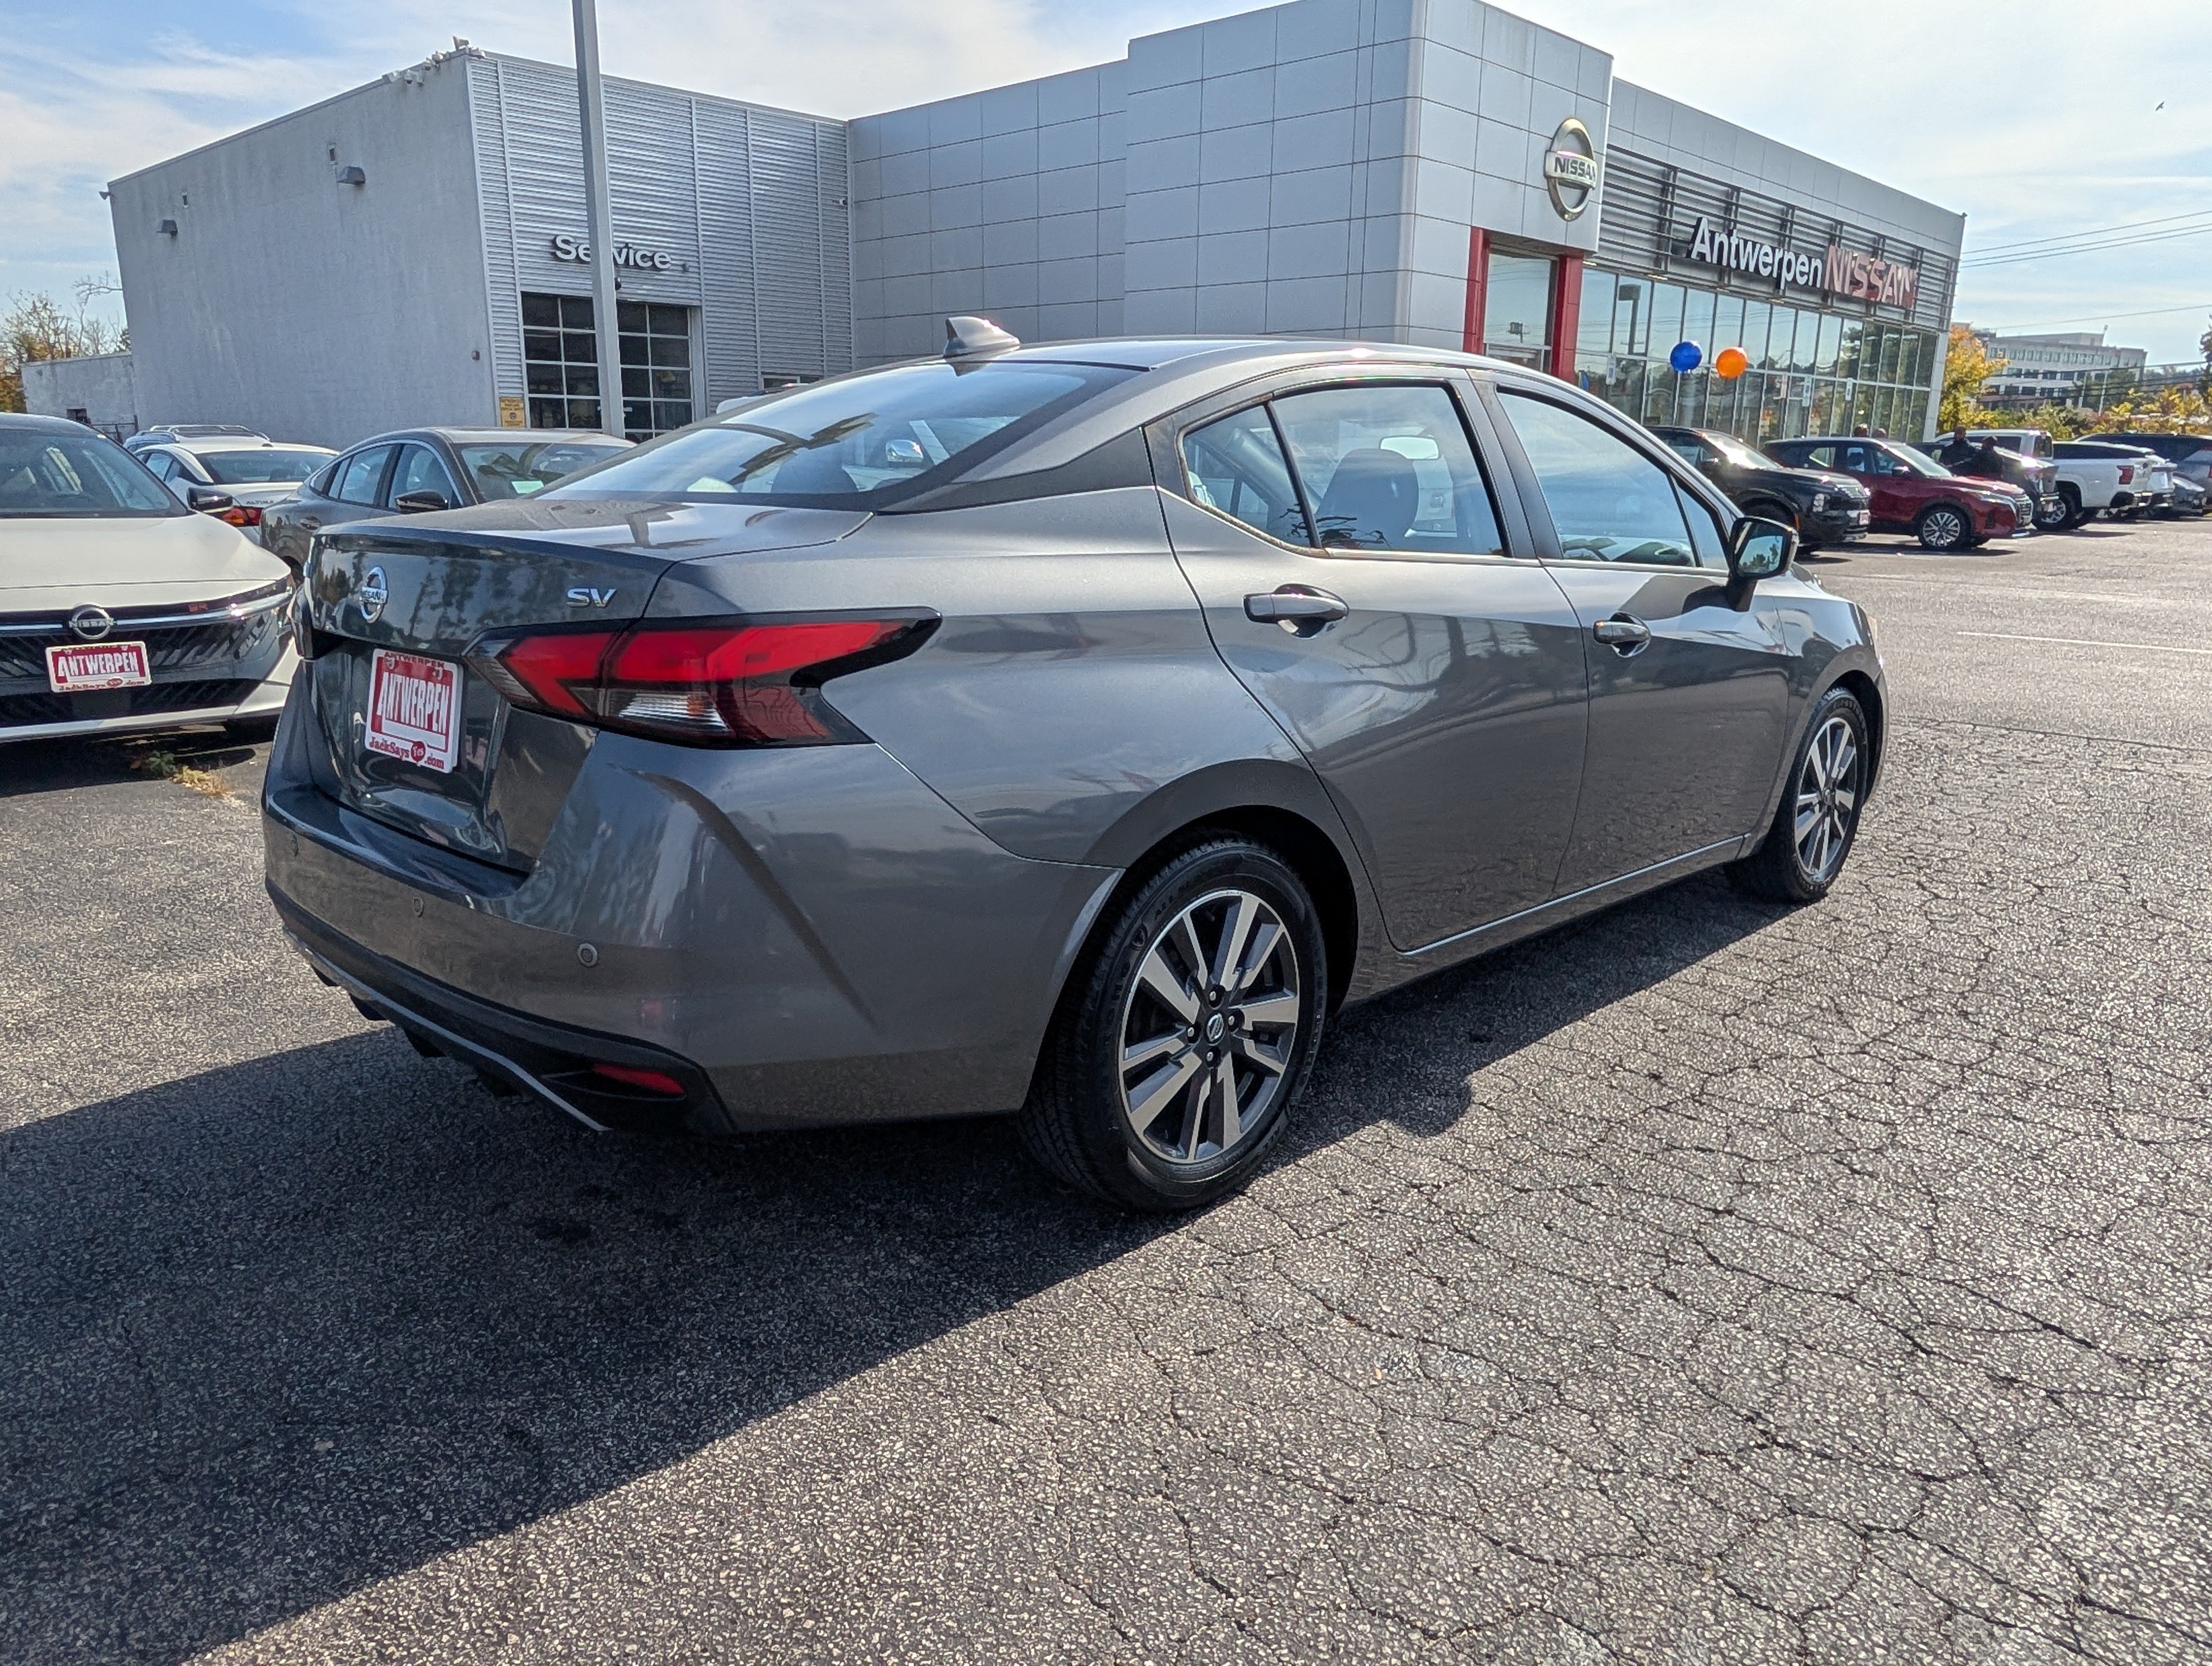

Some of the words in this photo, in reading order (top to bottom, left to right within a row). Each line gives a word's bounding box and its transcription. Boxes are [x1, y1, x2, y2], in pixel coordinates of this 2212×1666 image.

[555, 235, 672, 269] Sevice
[1690, 216, 1823, 290] Antwerpen
[1824, 244, 1918, 309] NISSAN
[567, 588, 616, 607] SV
[69, 617, 114, 628] NISSAN
[58, 651, 139, 677] ANTWERPEN
[376, 671, 450, 734] ANTWERPEN
[369, 736, 410, 759] JackSays
